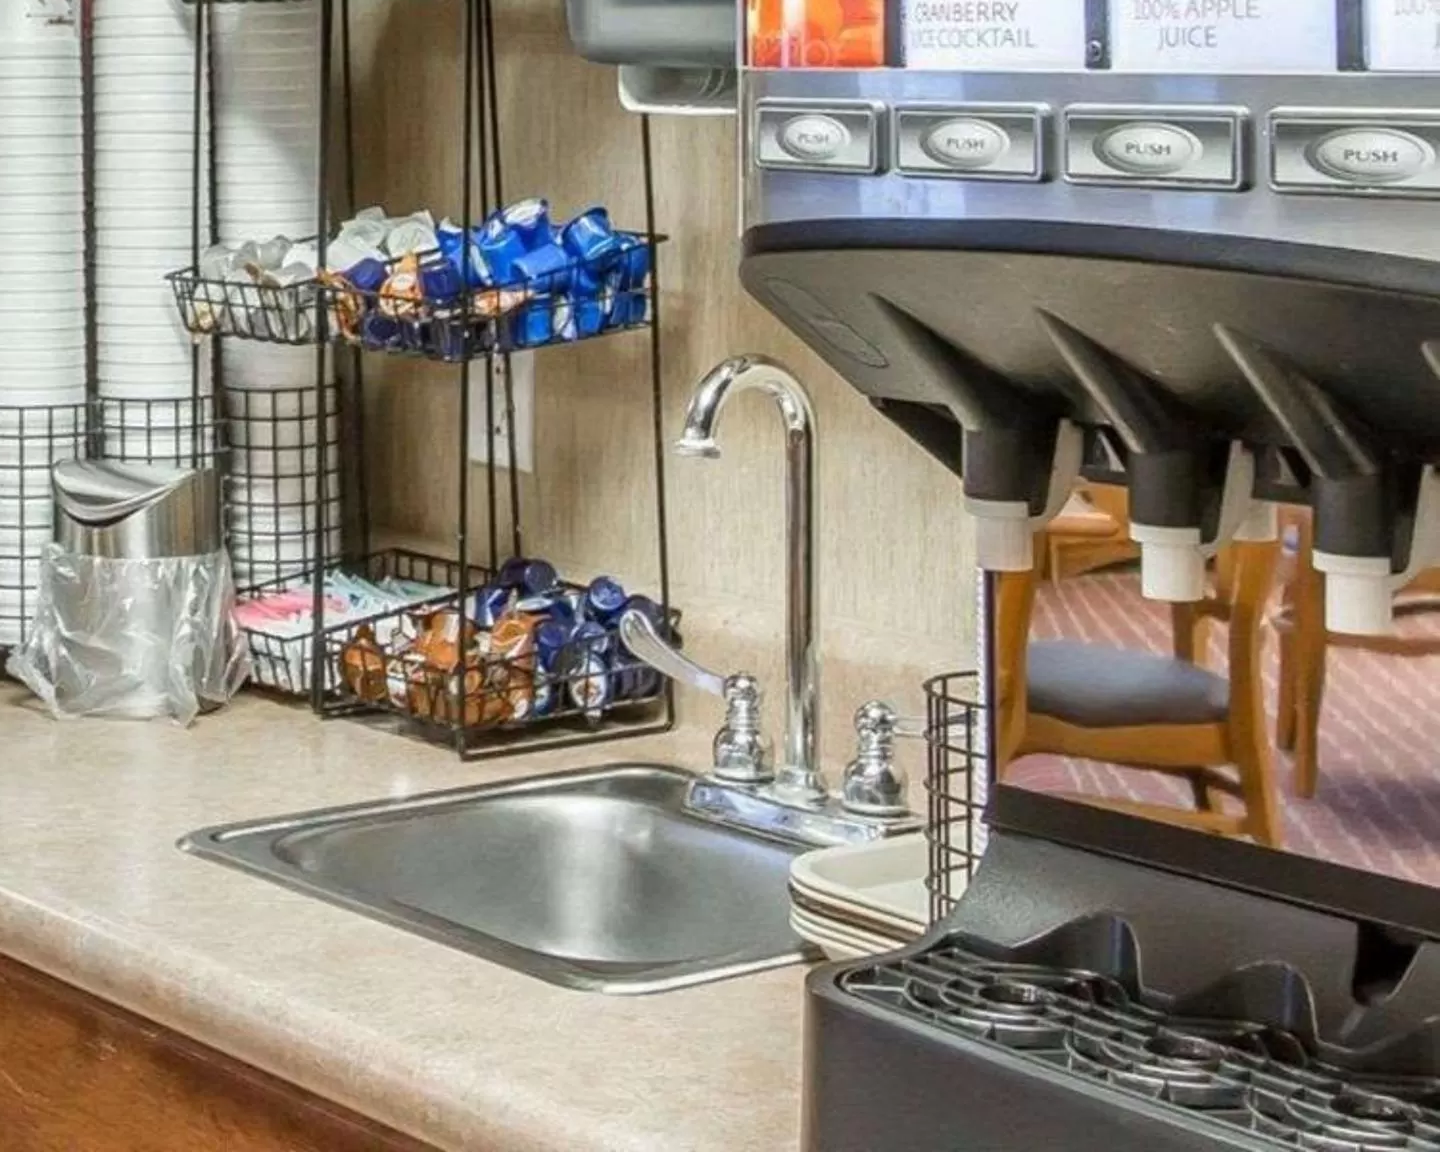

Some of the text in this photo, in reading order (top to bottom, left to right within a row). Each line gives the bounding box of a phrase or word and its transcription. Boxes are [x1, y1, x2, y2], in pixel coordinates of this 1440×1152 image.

[1157, 24, 1218, 50] JUICE
[946, 136, 985, 149] PUSH
[1125, 142, 1172, 156] PUSH
[1343, 149, 1399, 163] PUSH
